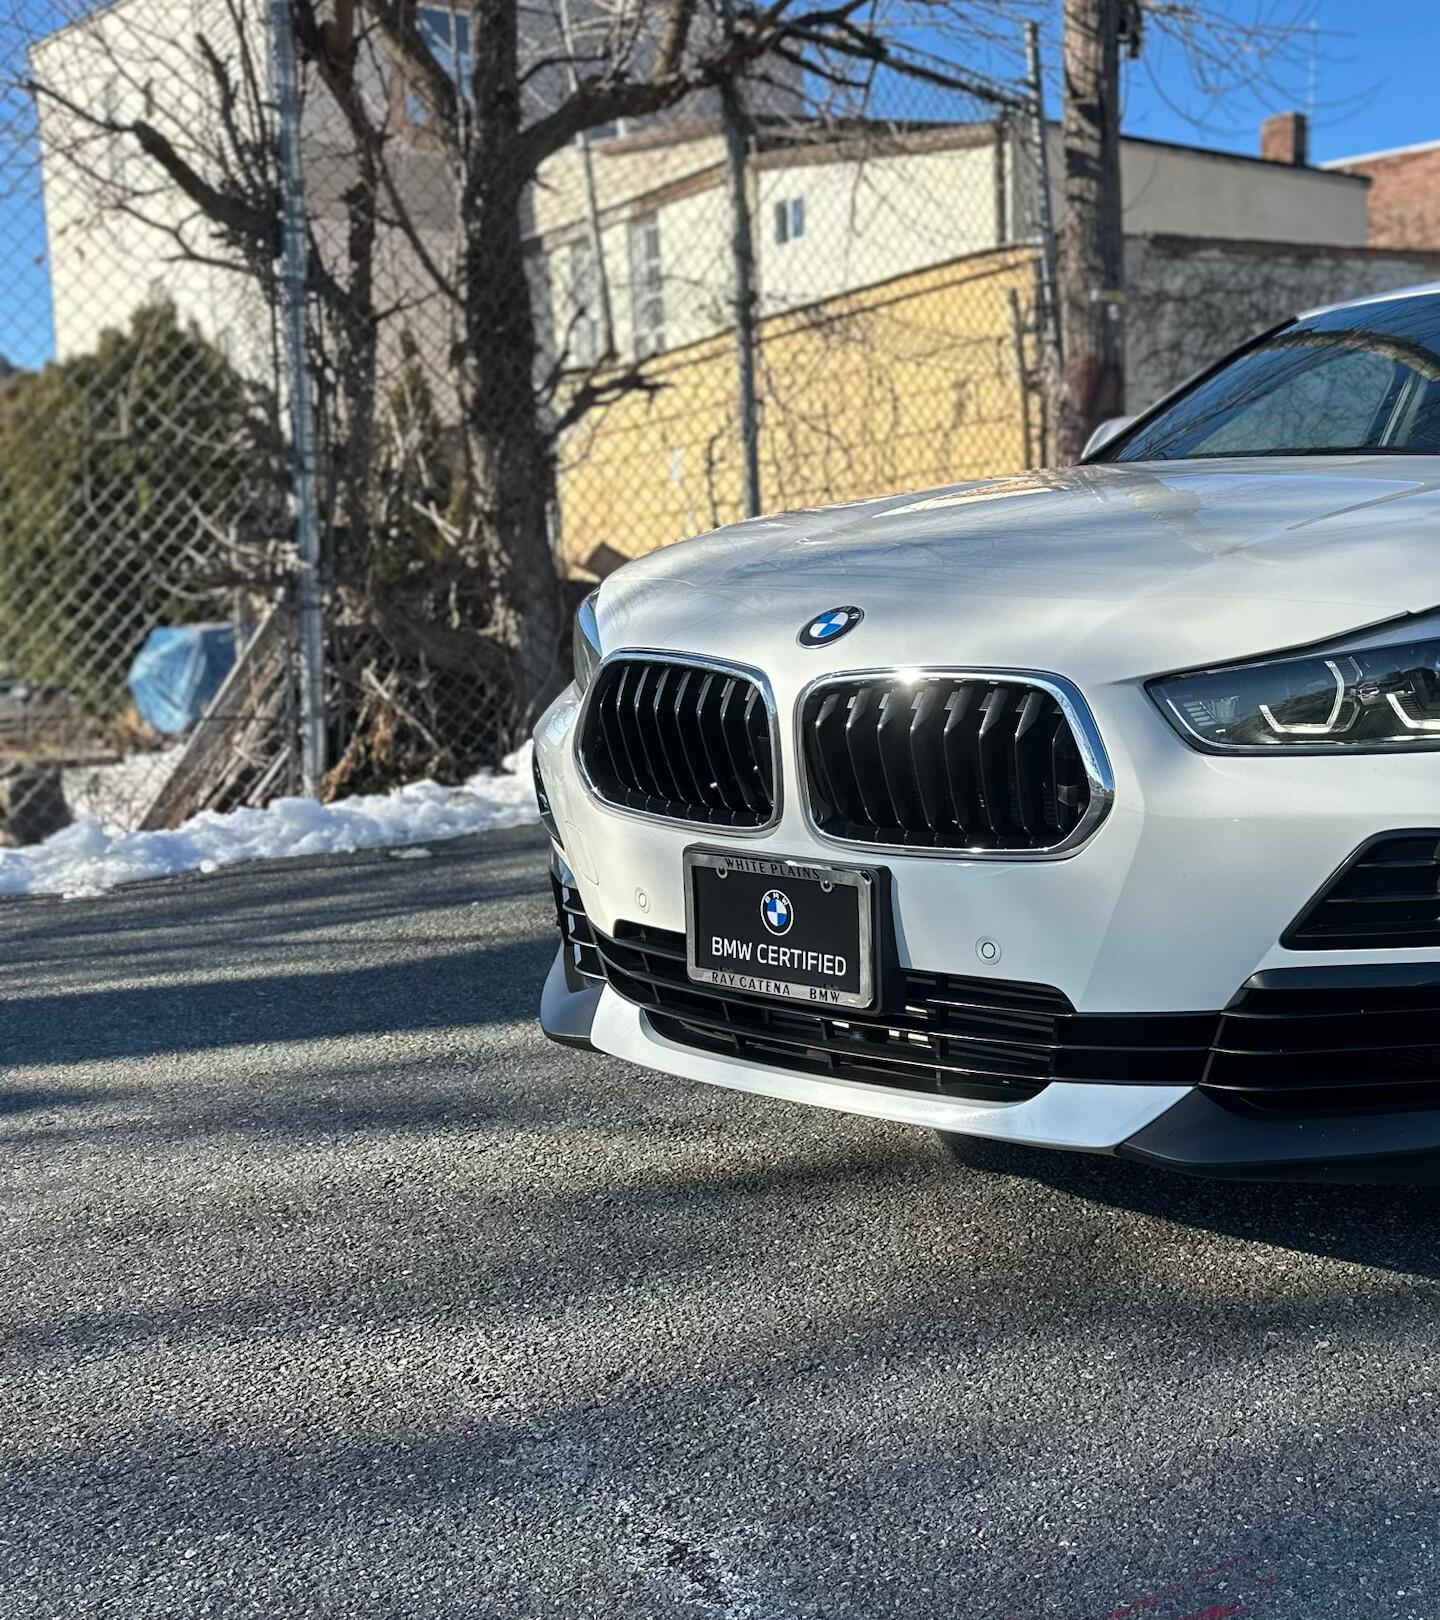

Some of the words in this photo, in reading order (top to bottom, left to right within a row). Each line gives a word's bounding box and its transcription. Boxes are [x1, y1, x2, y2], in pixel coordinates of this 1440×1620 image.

[724, 857, 766, 873] WHITE
[770, 863, 820, 880] PLAINS
[764, 892, 789, 907] BMW
[711, 936, 752, 960] BMW
[757, 943, 847, 977] CERTIFIED
[712, 971, 737, 986] RAY
[739, 976, 791, 996] CATENA
[809, 987, 841, 1003] BMW
